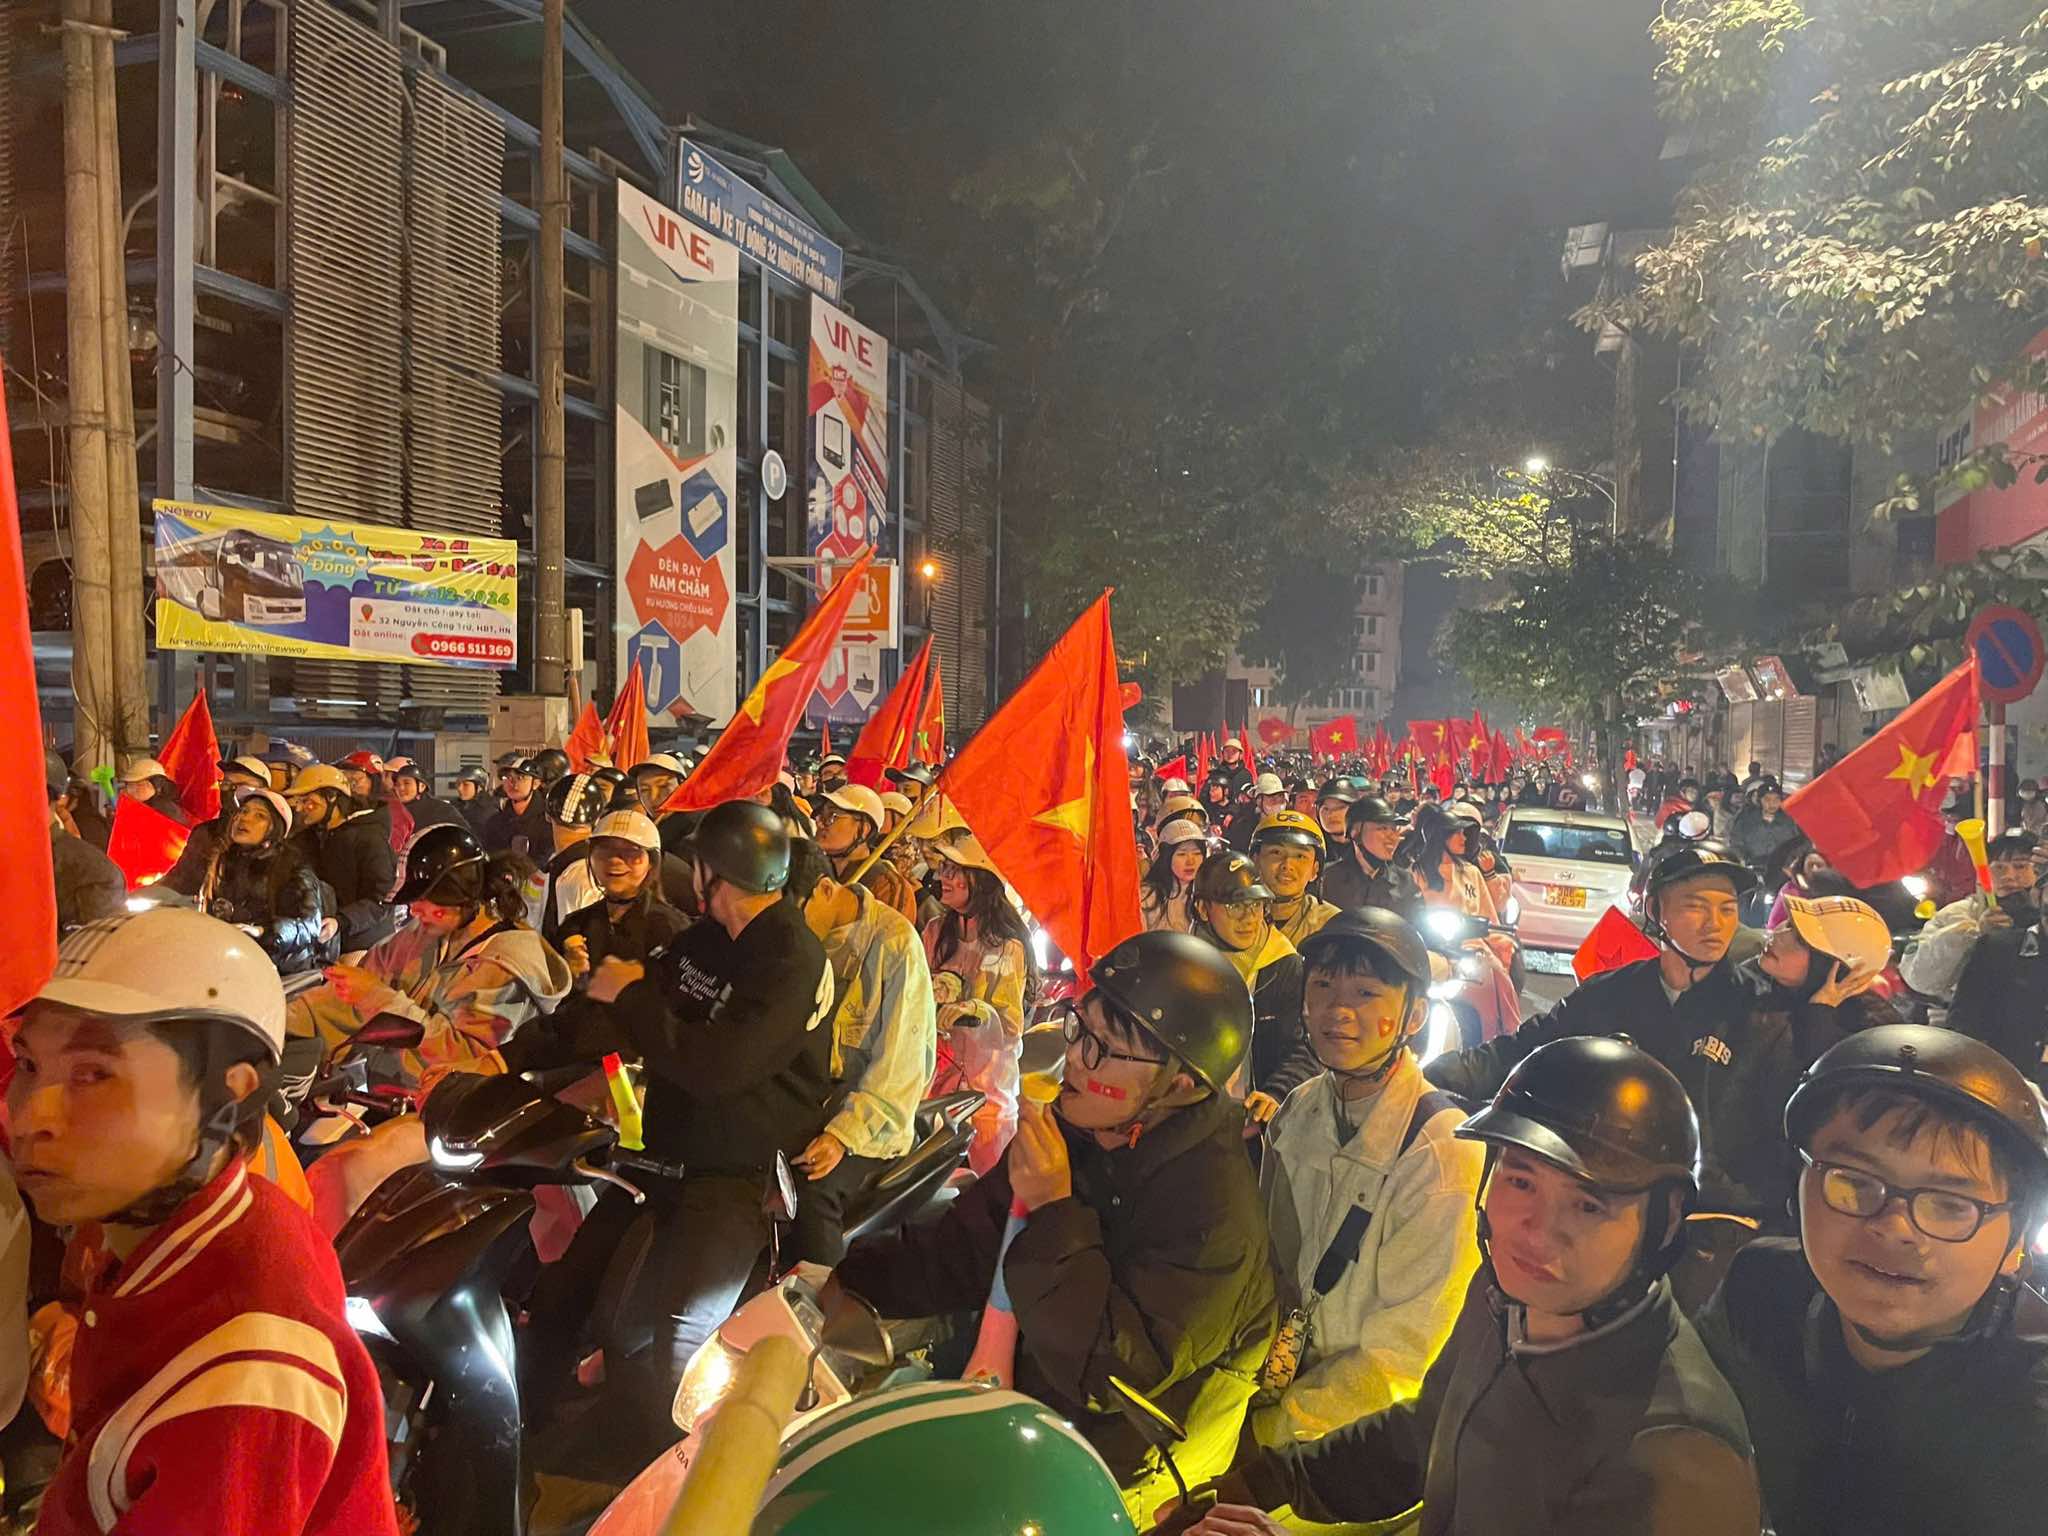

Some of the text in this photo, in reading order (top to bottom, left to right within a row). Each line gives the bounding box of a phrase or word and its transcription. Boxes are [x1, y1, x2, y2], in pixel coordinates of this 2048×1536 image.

[683, 185, 708, 221] GARA
[722, 209, 734, 238] XE
[658, 556, 702, 578] ĐÈN RAY
[649, 573, 710, 599] NAM CHÂM
[379, 616, 390, 625] 32
[431, 640, 511, 657] 0966 511 369
